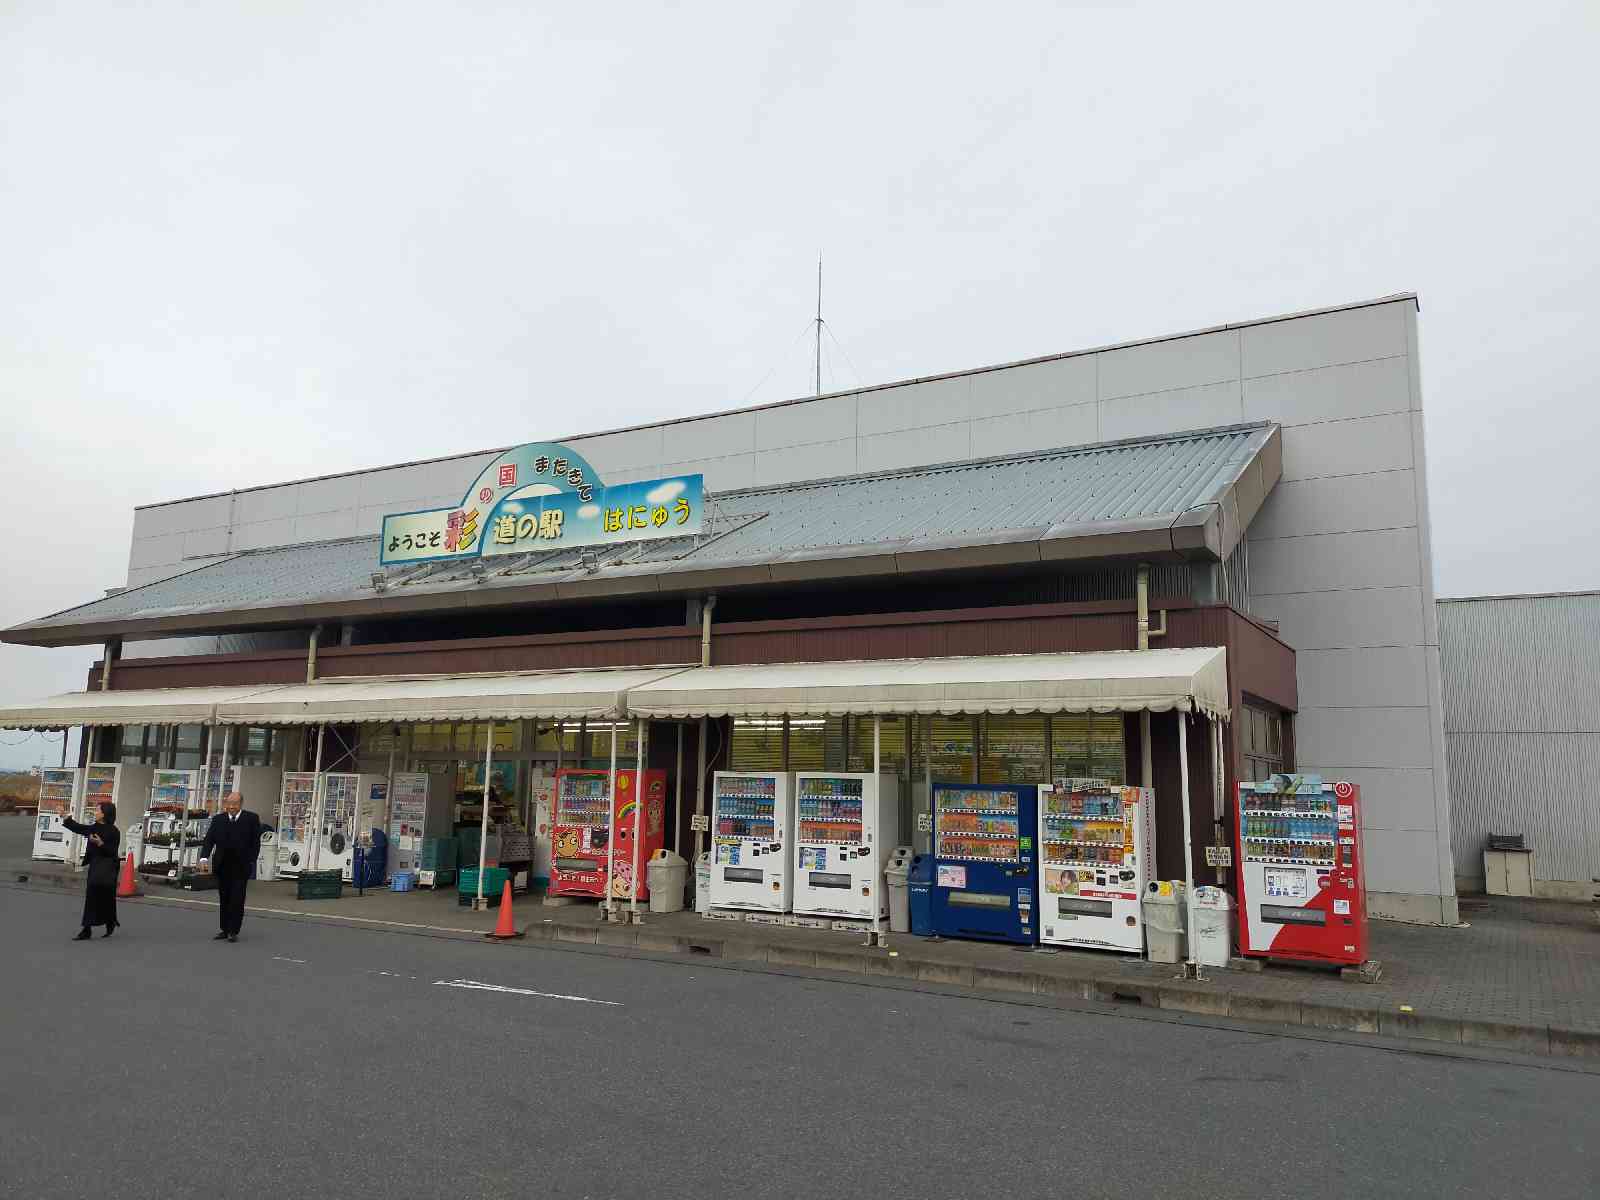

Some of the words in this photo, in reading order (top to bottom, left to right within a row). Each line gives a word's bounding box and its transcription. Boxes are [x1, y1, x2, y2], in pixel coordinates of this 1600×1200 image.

[535, 456, 592, 502] またきて
[495, 509, 564, 544] 道の駅
[603, 499, 690, 532] はにゅう
[388, 531, 440, 552] ようこそ
